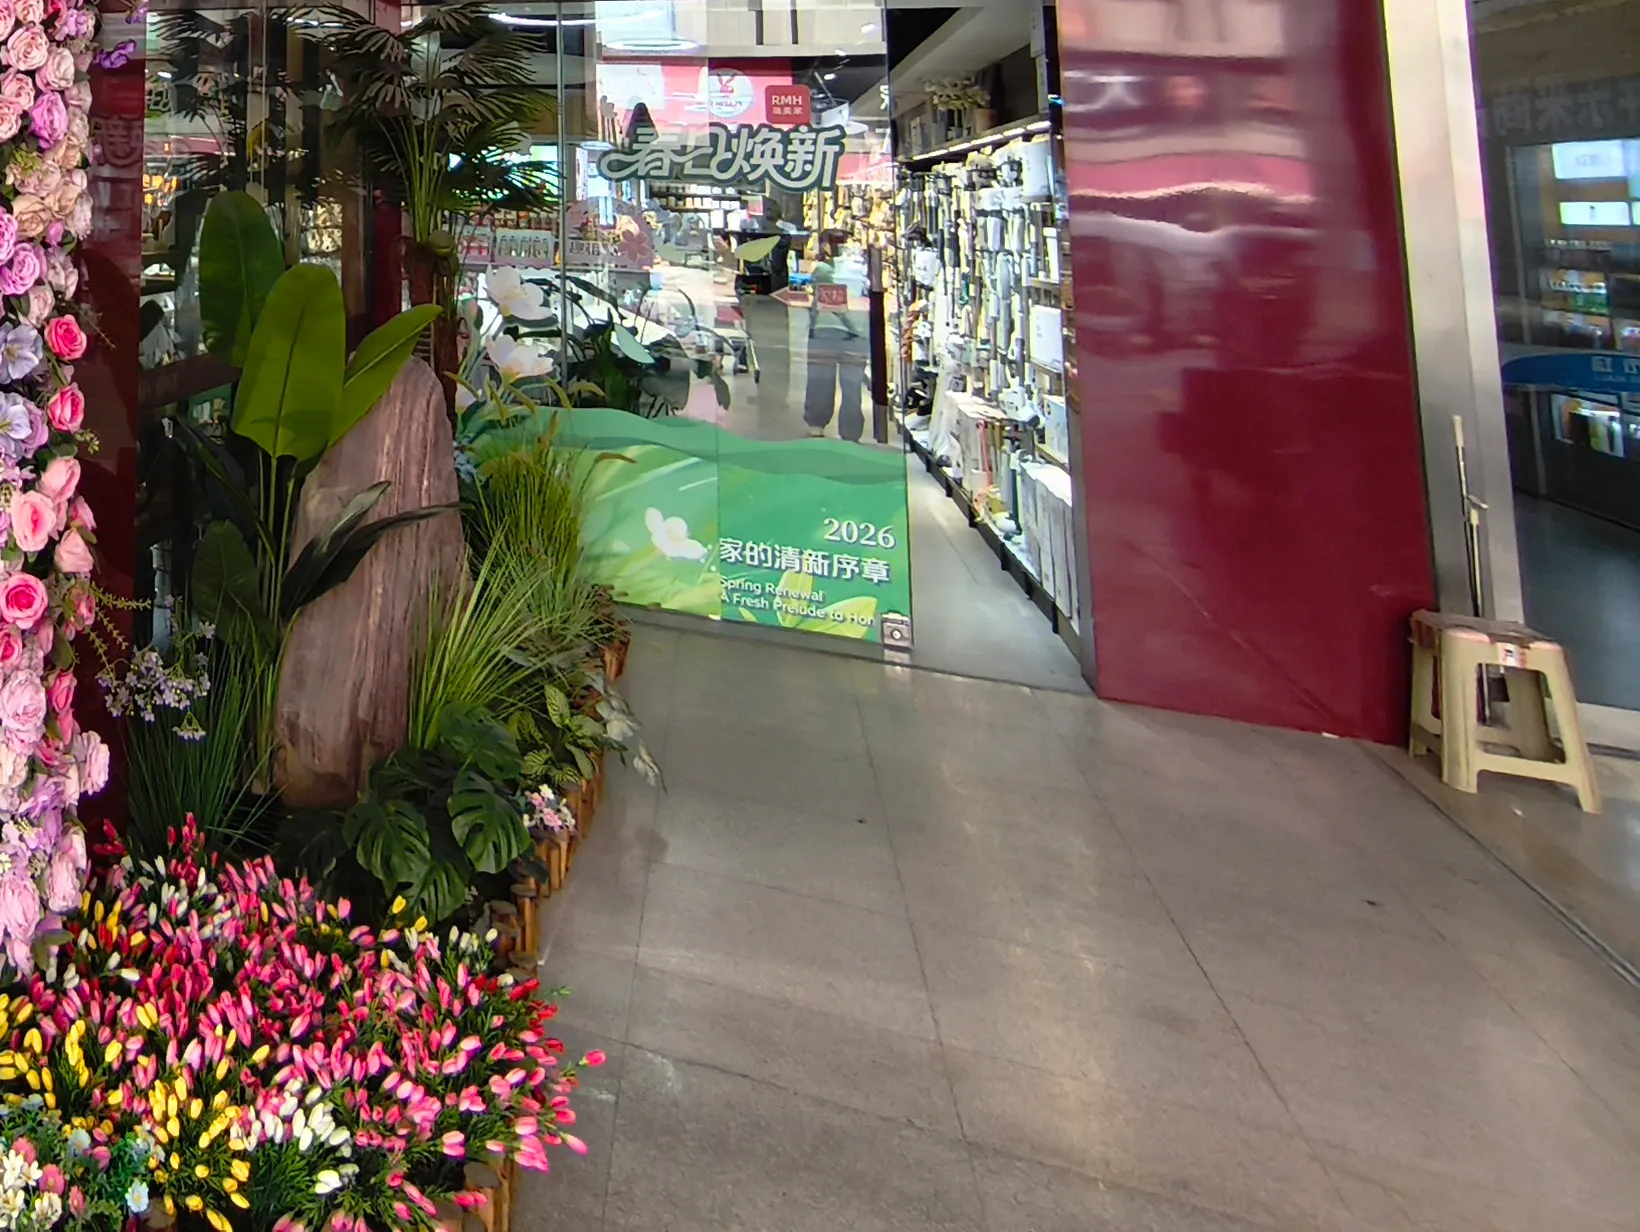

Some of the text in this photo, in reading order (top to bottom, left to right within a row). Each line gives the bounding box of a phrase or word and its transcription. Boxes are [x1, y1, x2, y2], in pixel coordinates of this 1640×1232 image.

[771, 95, 803, 106] RMH
[599, 125, 844, 189] 春日焕新
[823, 518, 896, 549] 2026
[719, 537, 891, 584] 家的清新序章
[719, 574, 825, 603] Spring Renewal
[720, 590, 730, 604] A
[732, 592, 770, 610] Fresh
[773, 597, 826, 619] Prelude
[830, 609, 845, 623] to
